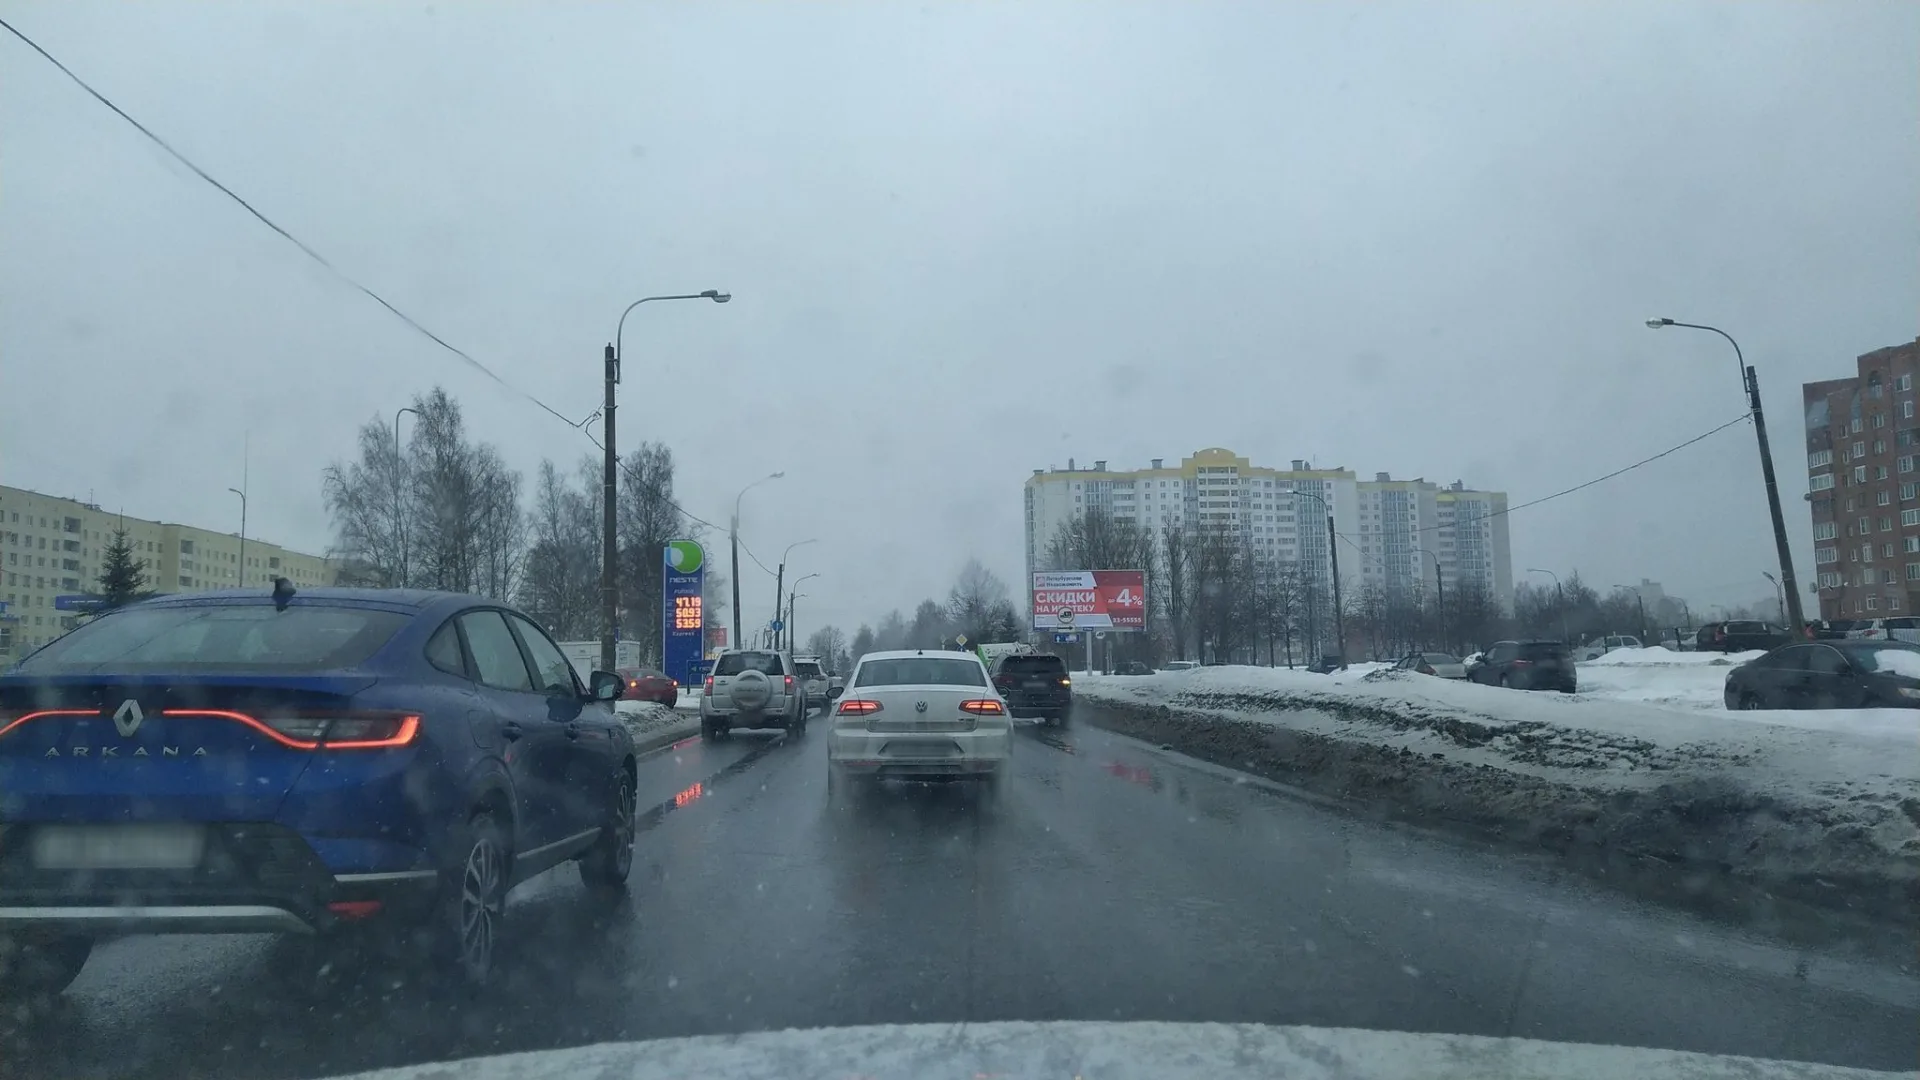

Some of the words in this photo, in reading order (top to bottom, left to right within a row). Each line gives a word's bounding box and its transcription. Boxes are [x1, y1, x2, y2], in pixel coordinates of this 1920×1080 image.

[1036, 591, 1096, 604] СКИДКИ
[1036, 605, 1049, 613] НА
[44, 745, 209, 758] ARKANA
